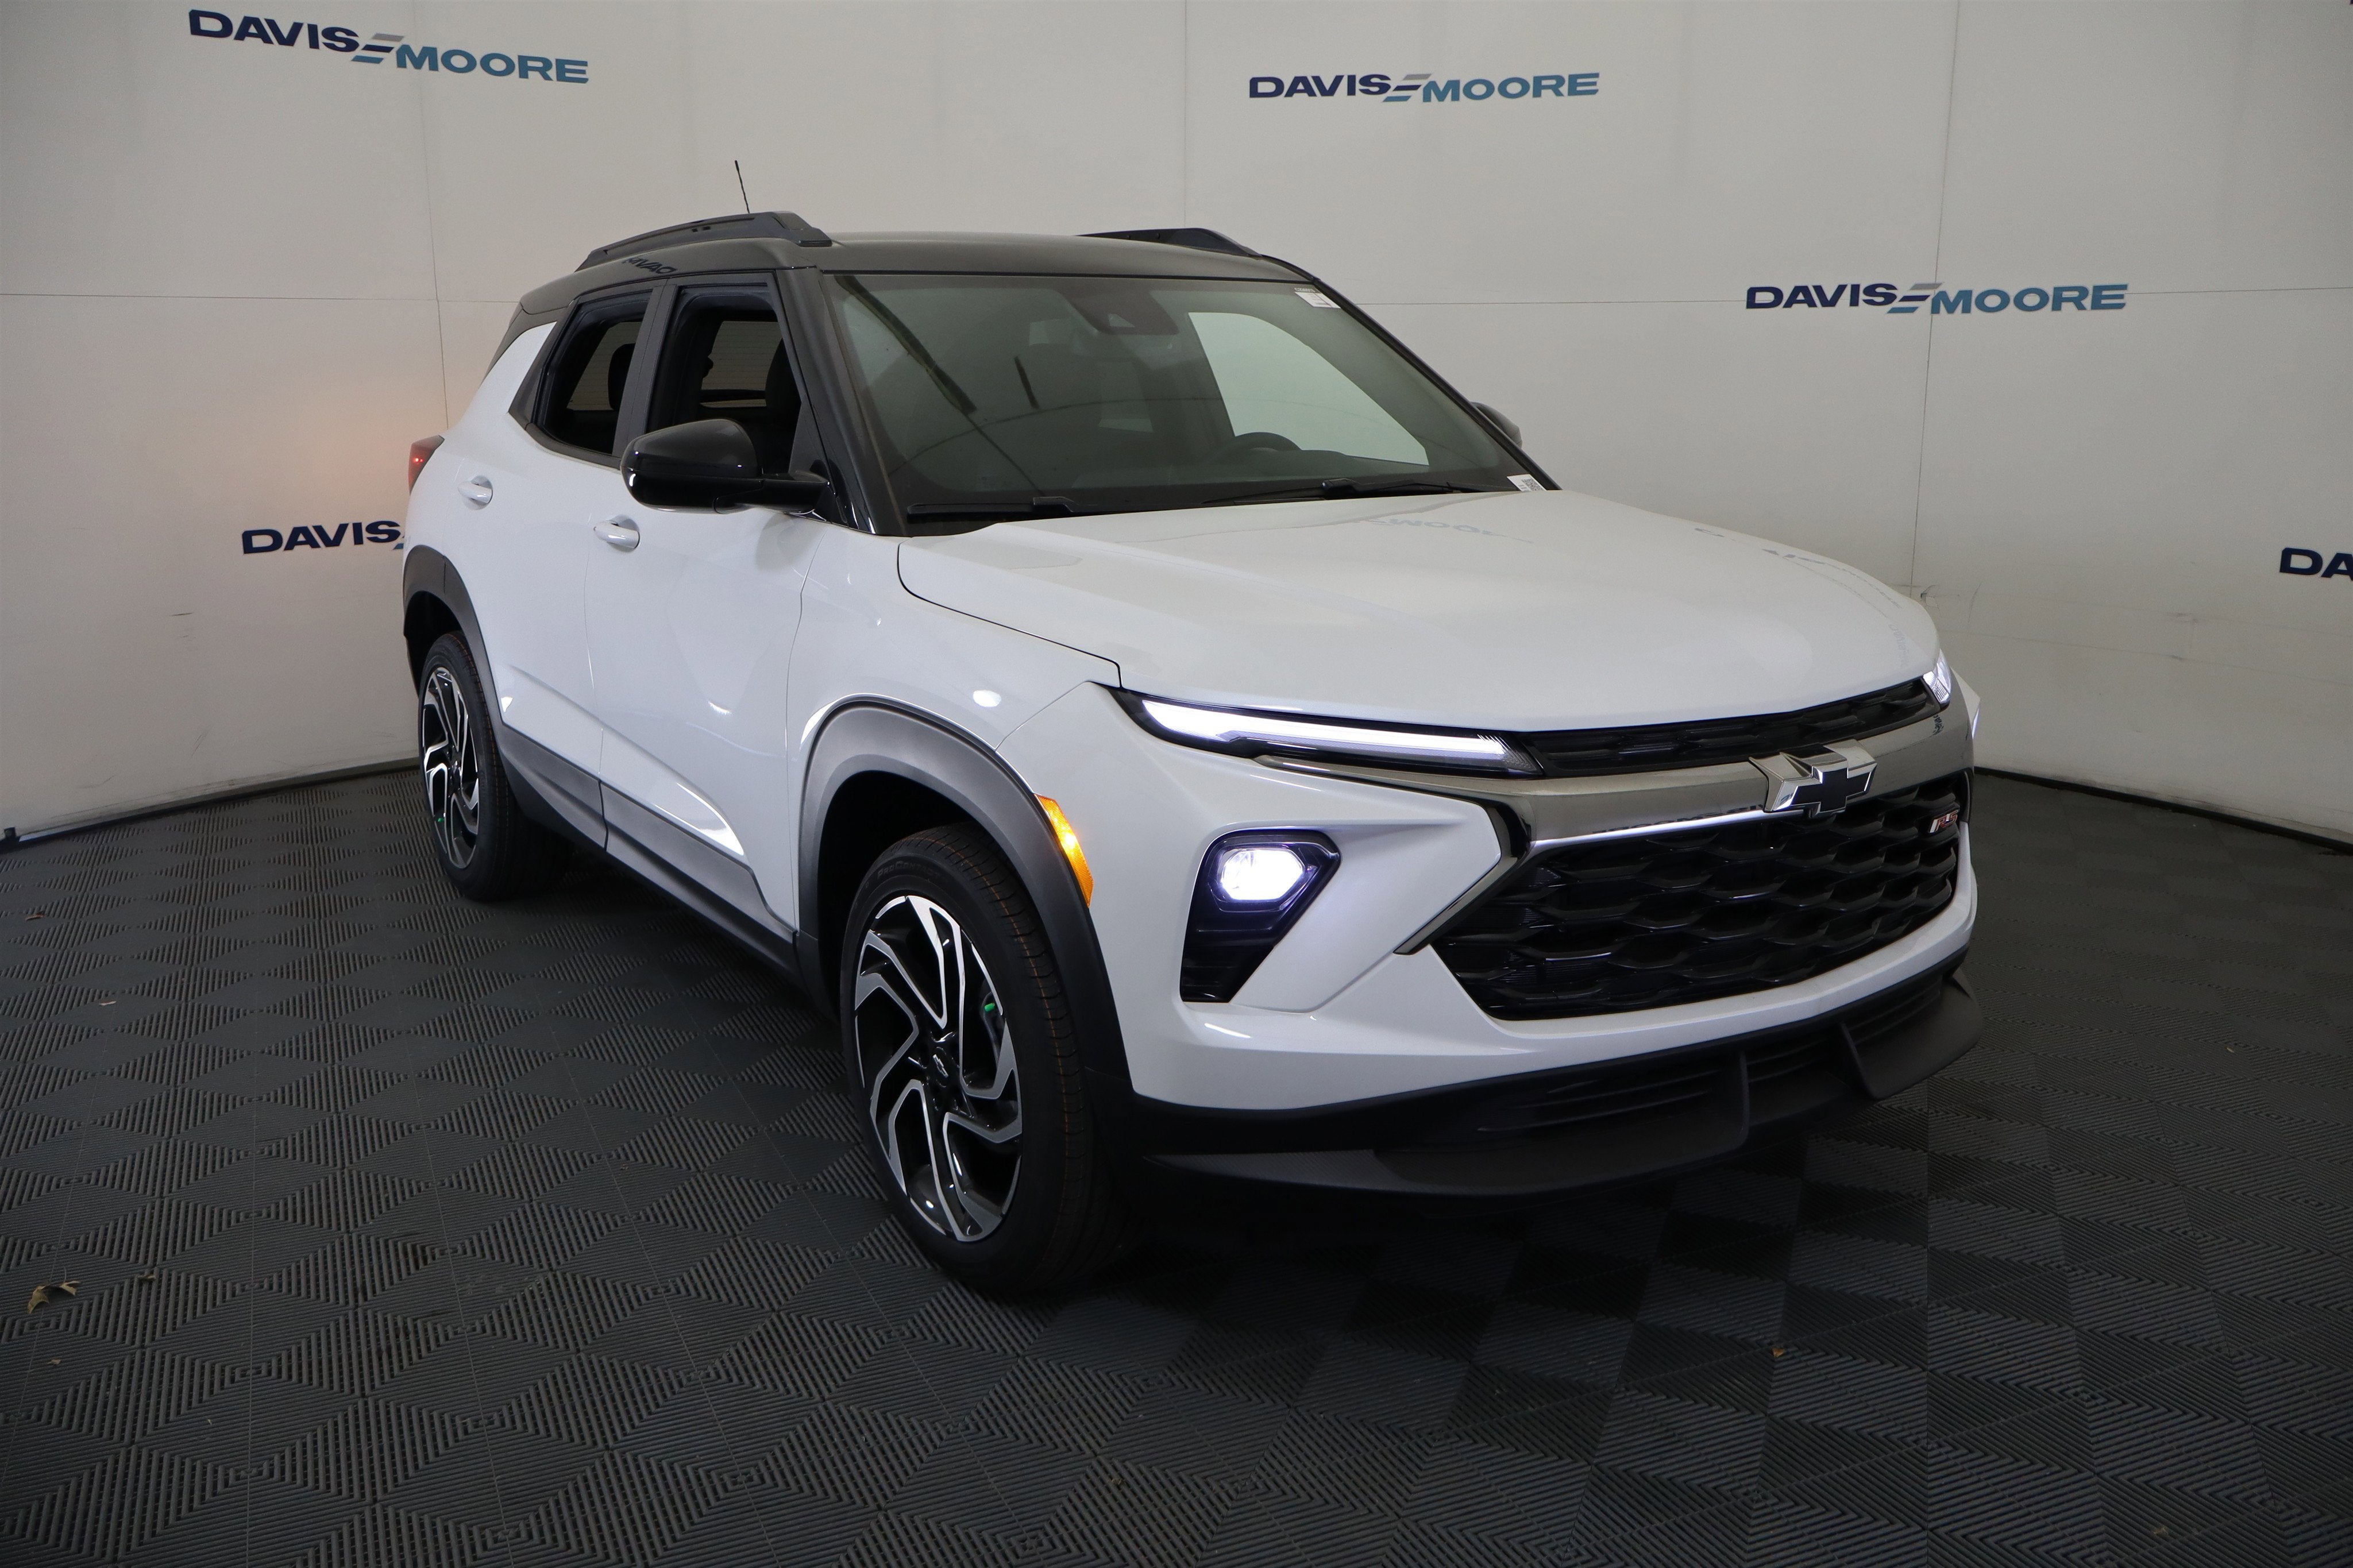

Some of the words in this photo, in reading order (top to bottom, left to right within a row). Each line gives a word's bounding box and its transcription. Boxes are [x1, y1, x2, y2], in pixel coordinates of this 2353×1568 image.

[189, 9, 360, 52] DAVIS
[396, 44, 589, 84] MOORE
[1249, 73, 1391, 98] DAVIS
[1422, 72, 1600, 103] MOORE
[1746, 282, 1897, 308] DAVIS
[1930, 283, 2128, 314] MOORE
[241, 519, 401, 554] DAVIS
[2279, 546, 2353, 581] DA
[1929, 809, 1958, 834] RS
